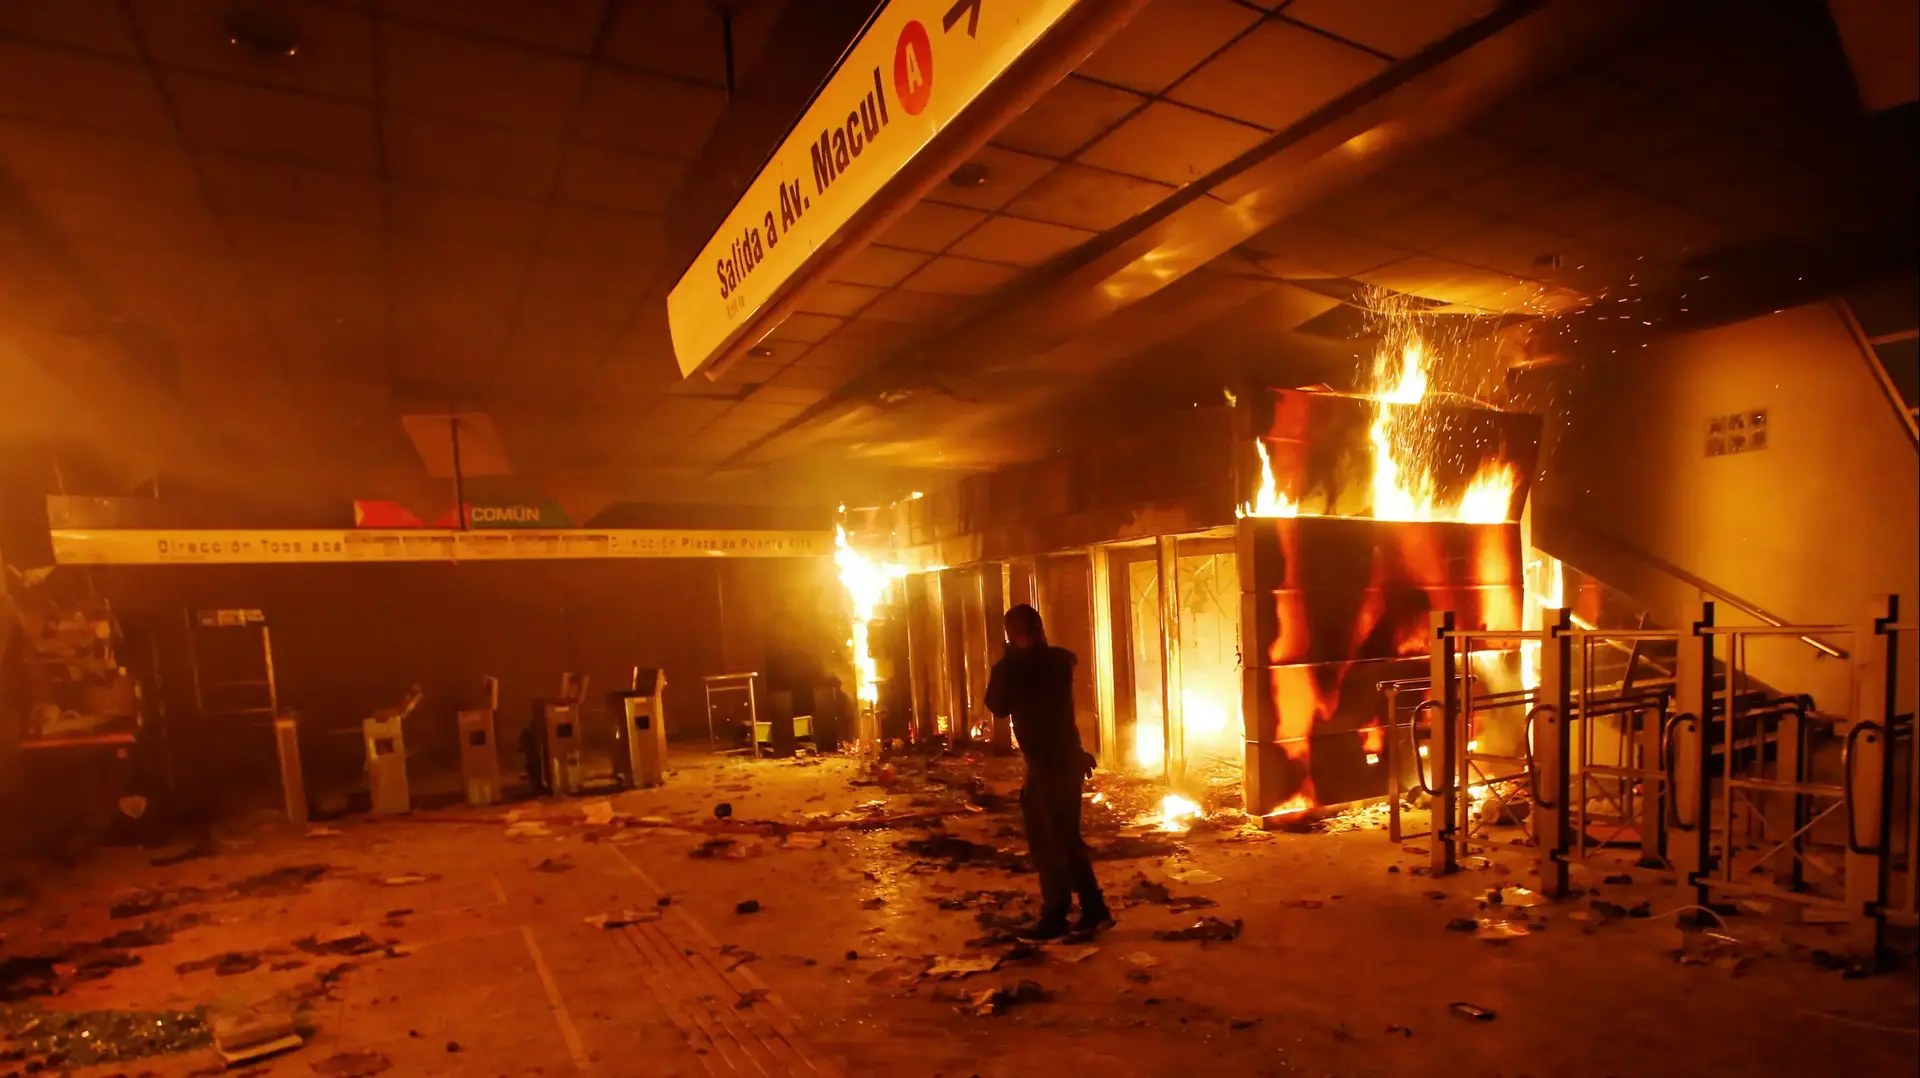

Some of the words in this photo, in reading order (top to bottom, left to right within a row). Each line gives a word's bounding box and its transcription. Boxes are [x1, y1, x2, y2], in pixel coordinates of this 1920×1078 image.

[717, 227, 763, 300] Salida
[764, 210, 778, 249] a
[779, 178, 810, 235] Av.
[810, 65, 889, 196] Macul
